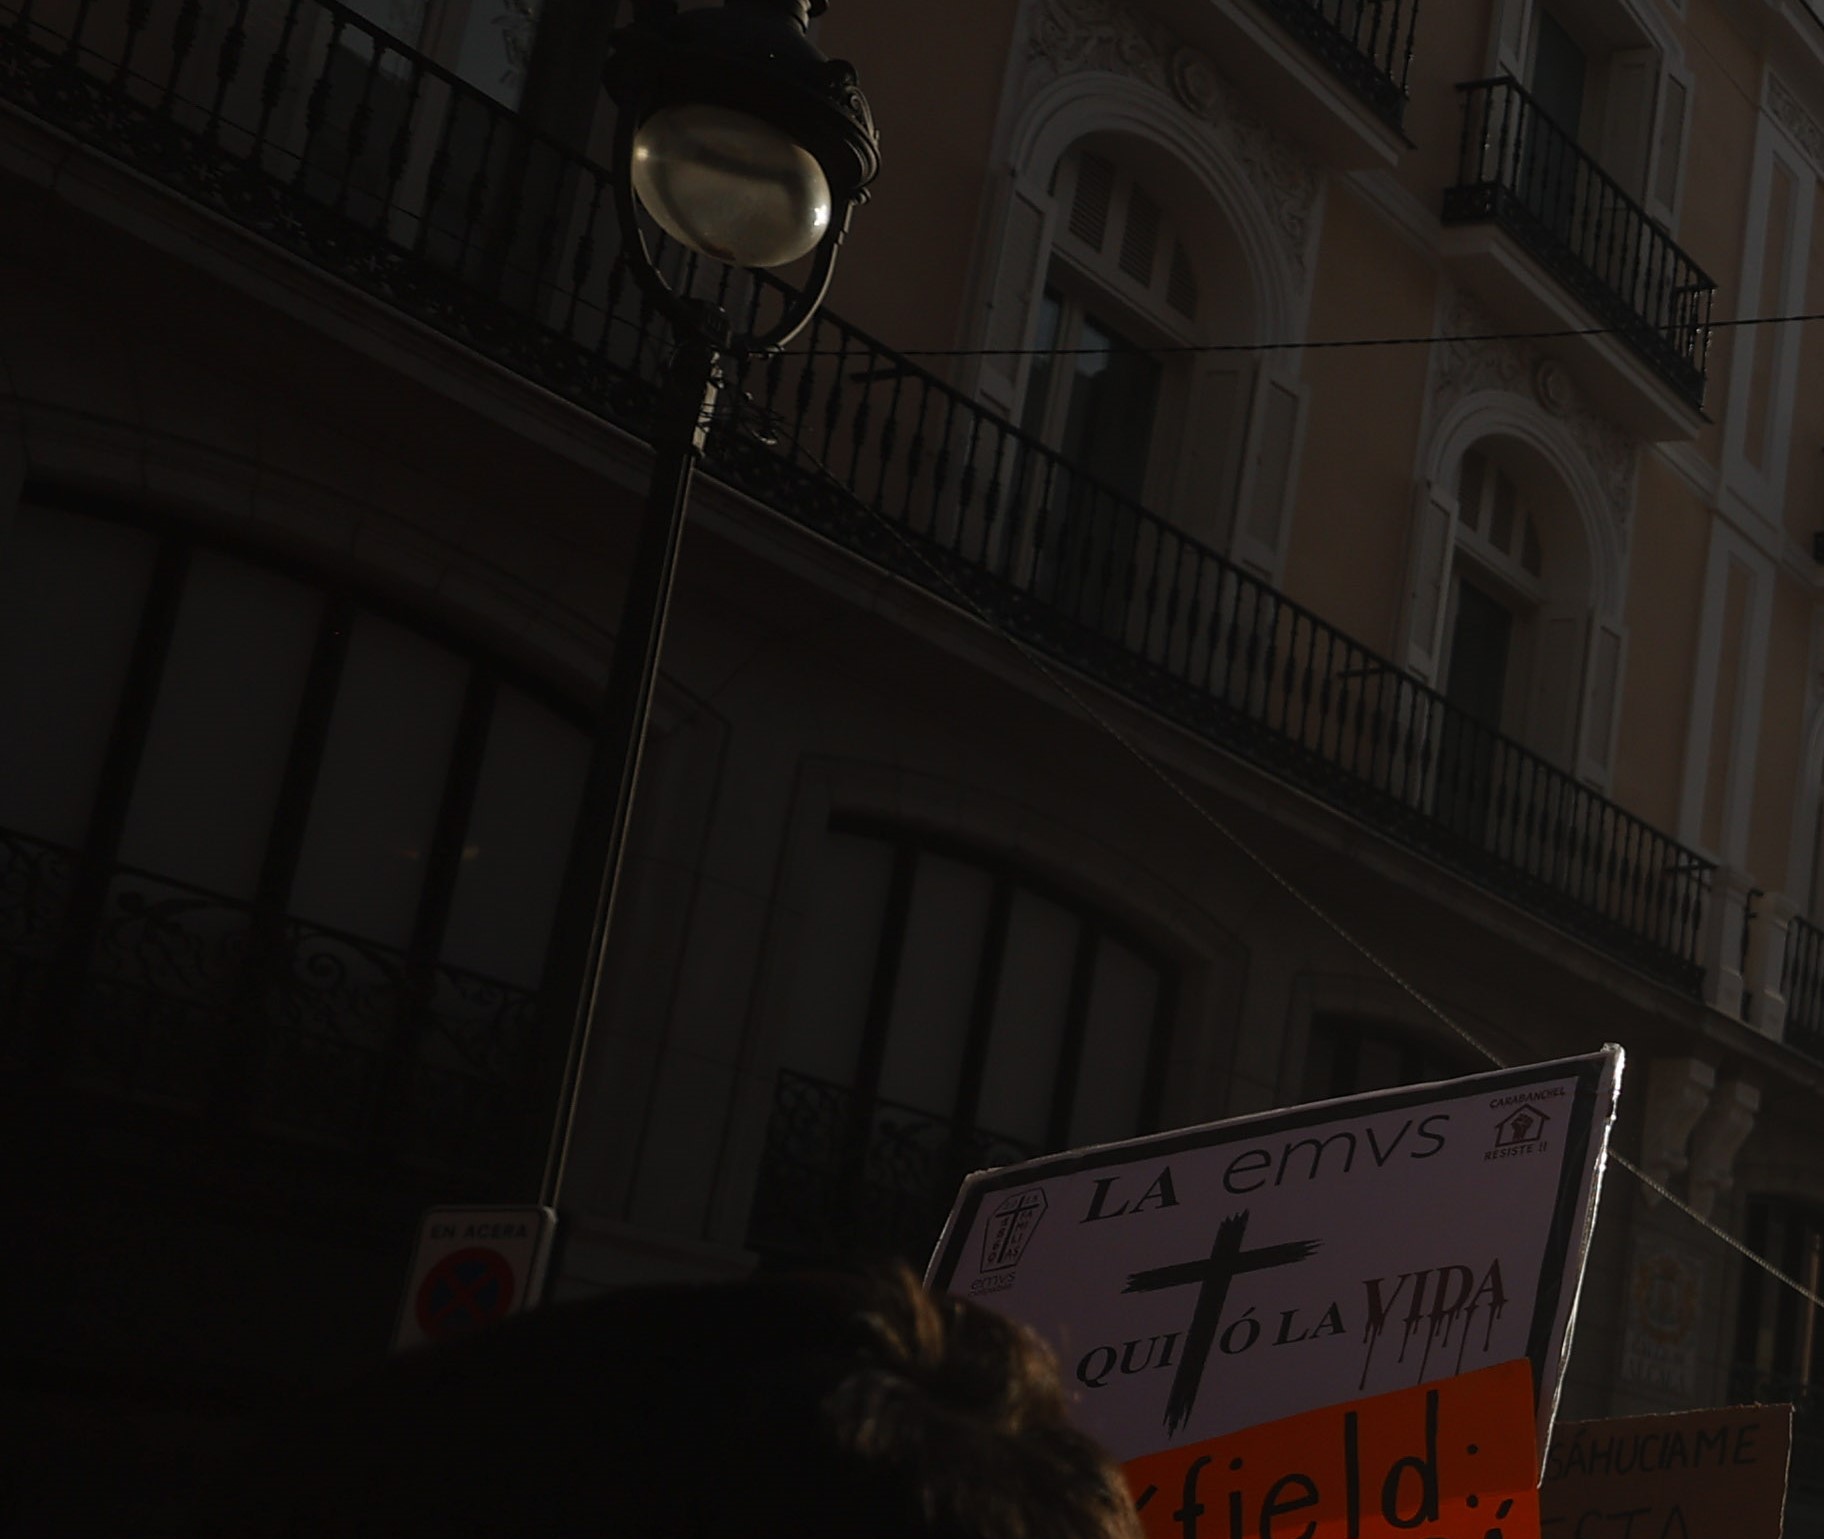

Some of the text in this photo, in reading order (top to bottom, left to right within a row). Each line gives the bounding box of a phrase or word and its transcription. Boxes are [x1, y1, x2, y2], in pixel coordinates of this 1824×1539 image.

[1489, 1087, 1566, 1108] CARABANCHEL
[1484, 1142, 1534, 1161] RESISTE
[1080, 1114, 1451, 1224] LA emvs
[431, 1224, 528, 1239] EN ACERA
[1272, 1302, 1346, 1347] LA
[1361, 1258, 1507, 1358] VIDA
